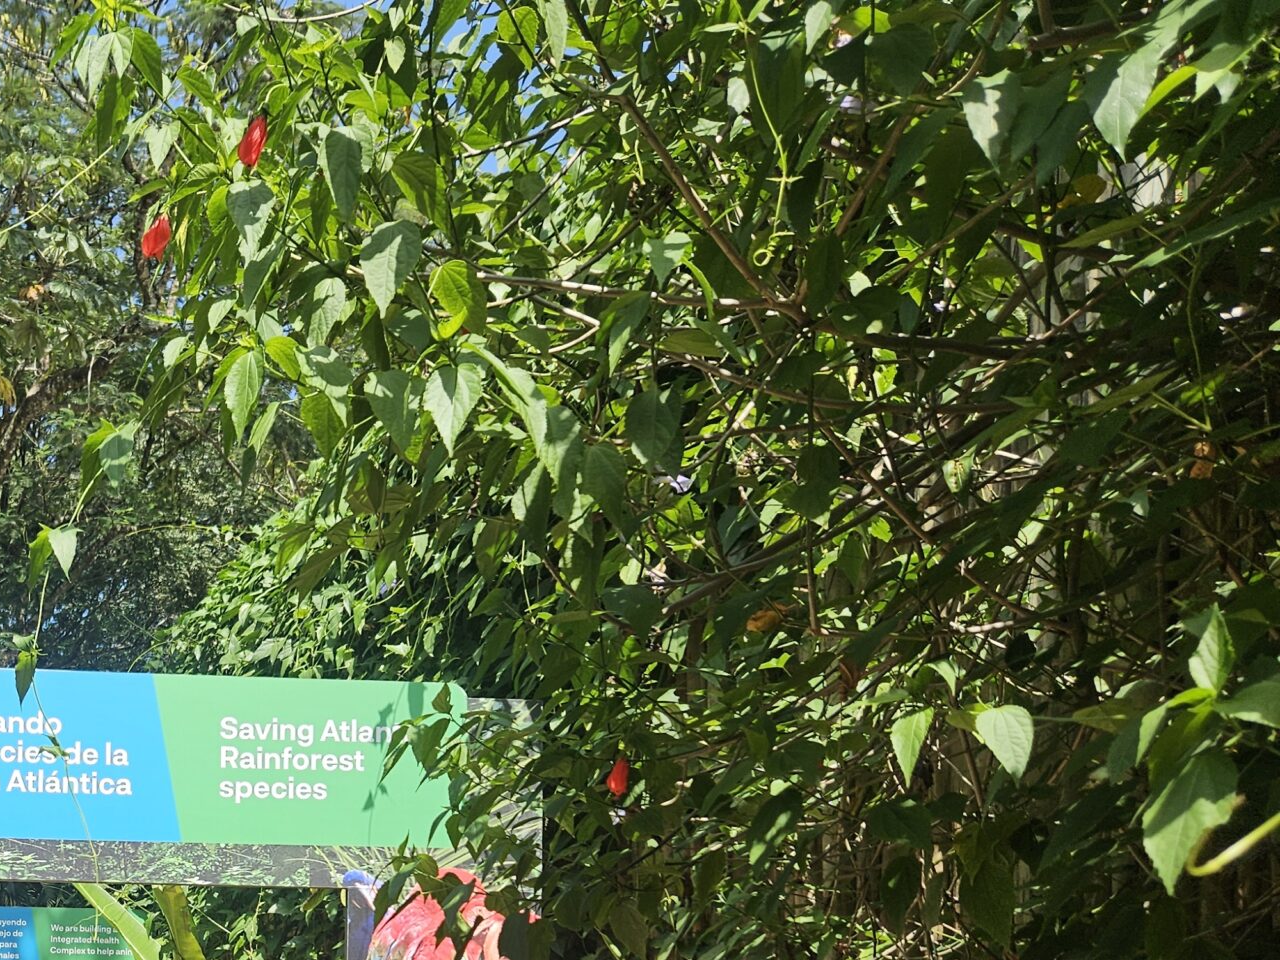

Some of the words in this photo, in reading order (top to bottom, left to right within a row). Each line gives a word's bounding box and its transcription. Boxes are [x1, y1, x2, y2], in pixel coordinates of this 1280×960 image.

[219, 716, 315, 747] Saving
[319, 719, 401, 744] Atlan
[66, 741, 99, 765] de
[105, 742, 130, 766] la
[219, 745, 365, 771] Rainforest
[6, 769, 133, 795] Atlántica
[219, 776, 328, 803] species
[50, 924, 64, 932] We
[79, 925, 112, 934] building
[50, 935, 92, 944] Integrated
[93, 936, 120, 944] Health
[0, 941, 18, 949] para
[49, 946, 86, 955] Complex
[87, 947, 96, 955] to
[96, 947, 115, 956] help
